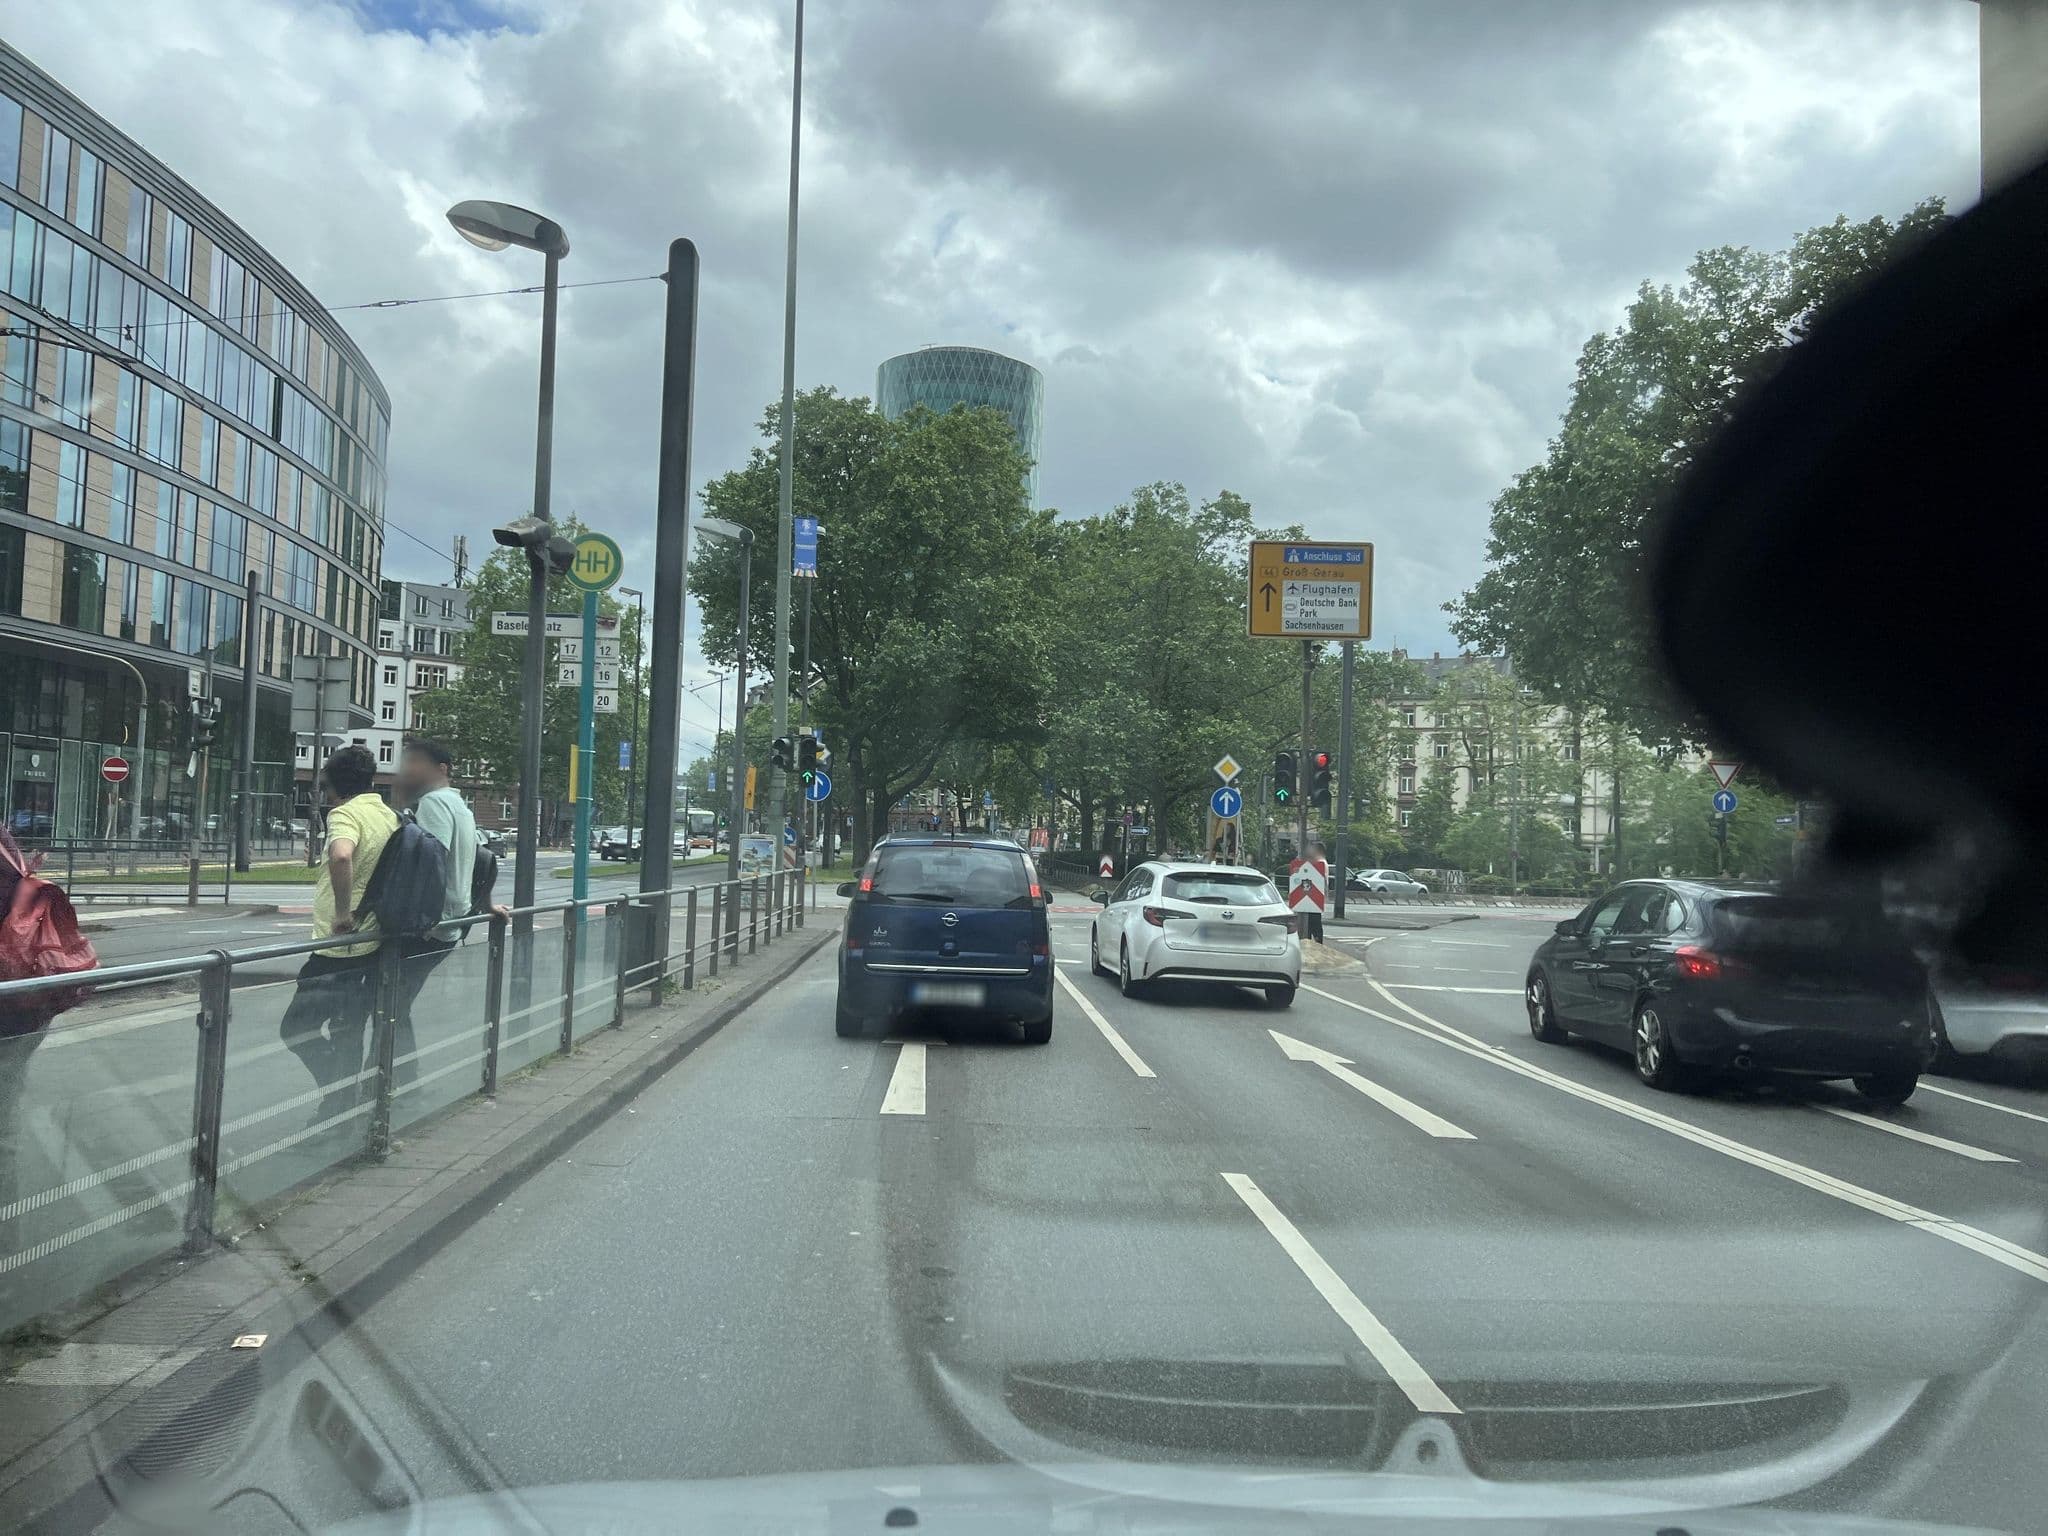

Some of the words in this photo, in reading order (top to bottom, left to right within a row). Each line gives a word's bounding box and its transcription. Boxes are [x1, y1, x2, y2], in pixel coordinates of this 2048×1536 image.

[1346, 551, 1361, 562] Süd
[1302, 584, 1354, 596] Flughafen
[1300, 597, 1335, 607] Deutsche
[1338, 598, 1358, 608] Bank
[1300, 608, 1318, 618] Park
[497, 620, 529, 631] Basele
[1285, 620, 1344, 631] Sachsenhausen
[564, 644, 577, 654] 17
[599, 646, 611, 656] 12
[563, 669, 575, 680] 21
[598, 671, 610, 681] 16
[597, 695, 610, 706] 20
